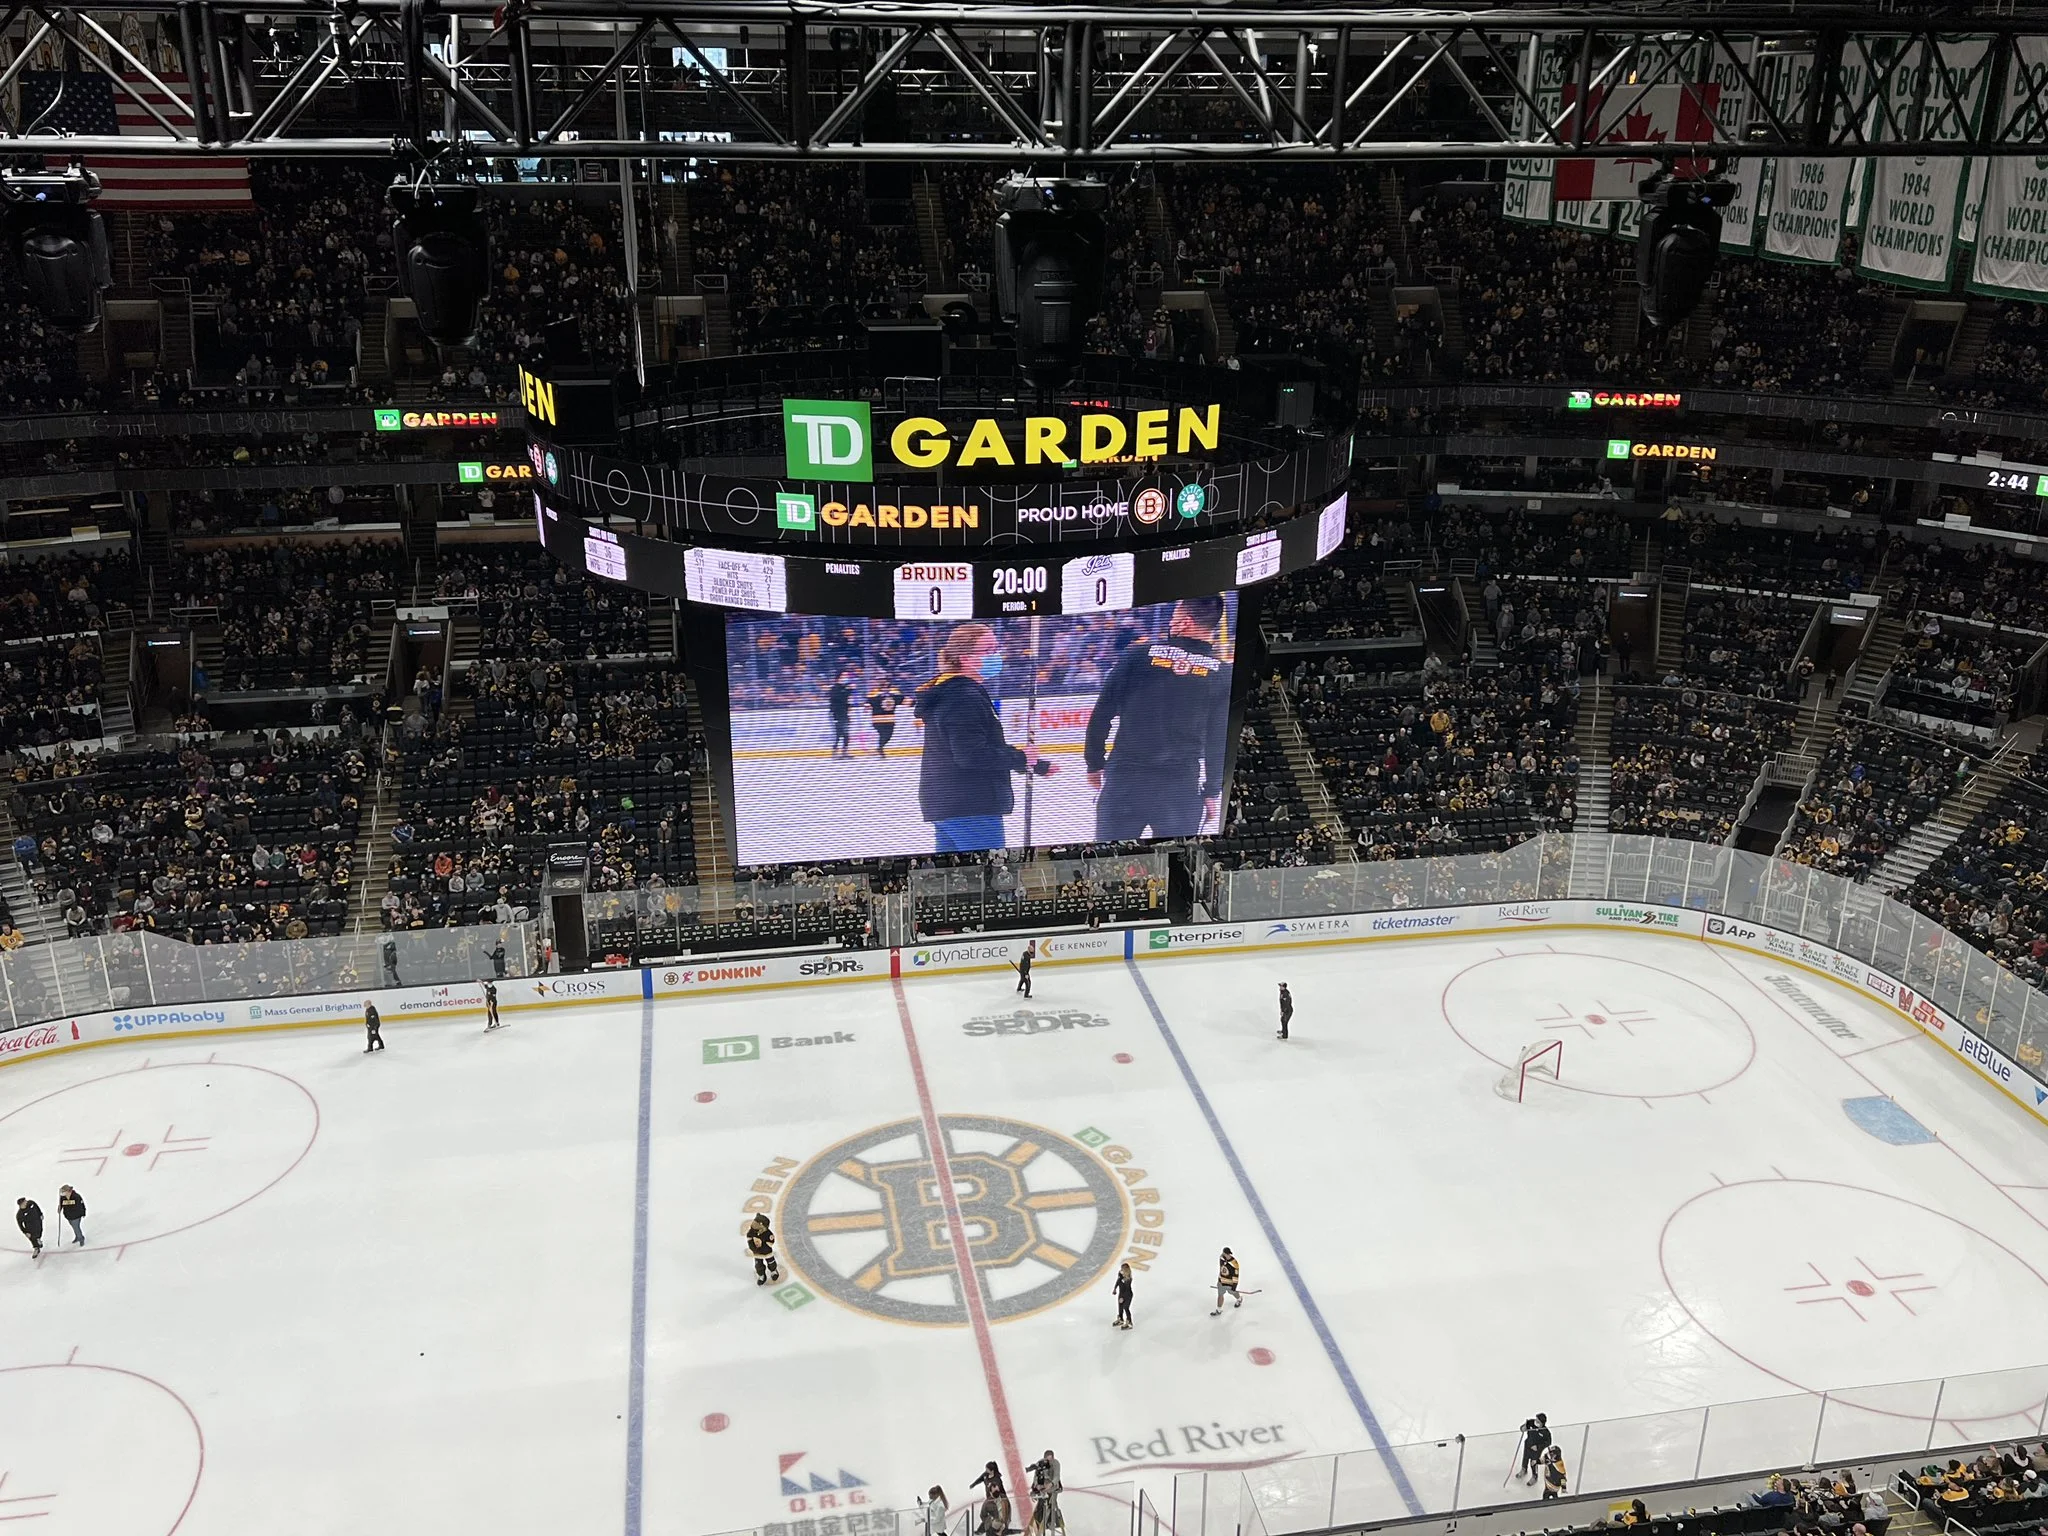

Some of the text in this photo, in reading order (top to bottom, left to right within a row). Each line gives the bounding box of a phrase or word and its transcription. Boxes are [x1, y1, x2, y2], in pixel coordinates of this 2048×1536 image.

[1800, 163, 1825, 185] 1986
[1902, 172, 1931, 198] 1984
[2023, 177, 2048, 202] 198
[1506, 181, 1525, 214] 34
[1790, 188, 1829, 212] WORLD
[1889, 198, 1935, 226] WORLD
[2007, 206, 2048, 235] WORL
[1772, 211, 1838, 240] CHAMPIONS
[1871, 225, 1944, 257] CHAMPIONS
[1984, 235, 2048, 265] CHAMPIO
[518, 363, 556, 426] DEN
[1594, 392, 1681, 407] GARDEN
[402, 411, 497, 428] GARDEN
[791, 404, 1221, 468] TD GARDEN
[1611, 443, 1717, 460] TD GARDEN
[462, 464, 533, 480] TD GAR
[1987, 471, 2029, 491] 2:44
[1179, 485, 1205, 501] CELTICS
[782, 500, 979, 529] TD GARDEN
[1018, 501, 1129, 523] PROUD HOME
[1161, 547, 1191, 562] PENALTIES
[825, 562, 860, 575] PENALTIES
[901, 566, 968, 581] BRUINS
[1082, 554, 1113, 576] Jets
[992, 565, 1047, 595] 20:00
[929, 586, 942, 615] 0
[1095, 577, 1107, 606] 0
[1002, 601, 1027, 612] PERIOD:
[550, 853, 586, 862] Encore
[1499, 904, 1551, 917] Red River
[1596, 907, 1680, 923] SULLIVAN TIRE
[1291, 919, 1350, 932] SYMETRA
[1372, 913, 1456, 932] ticketmaster
[1152, 929, 1243, 945] enterprise
[1766, 936, 1796, 948] DRAFT
[931, 945, 1009, 965] dynatrace
[1049, 940, 1109, 953] LEE KENNEDY
[1768, 941, 1794, 953] KINGS
[1799, 946, 1830, 961] DRAFT
[1802, 952, 1827, 965] KINGS
[1832, 959, 1860, 974] DRAFT
[697, 965, 767, 983] DUNKIN'
[1835, 965, 1858, 979] KINGS
[264, 1002, 362, 1018] Mass General Brigham
[399, 996, 483, 1011] demandscience
[1035, 1008, 1079, 1016] SECTOR
[134, 1010, 225, 1027] UPPAbaby
[708, 1031, 857, 1060] TD Bank
[1958, 1030, 2012, 1083] jetBlue
[1101, 1144, 1165, 1272] GARDEN
[1090, 1421, 1286, 1466] Red River
